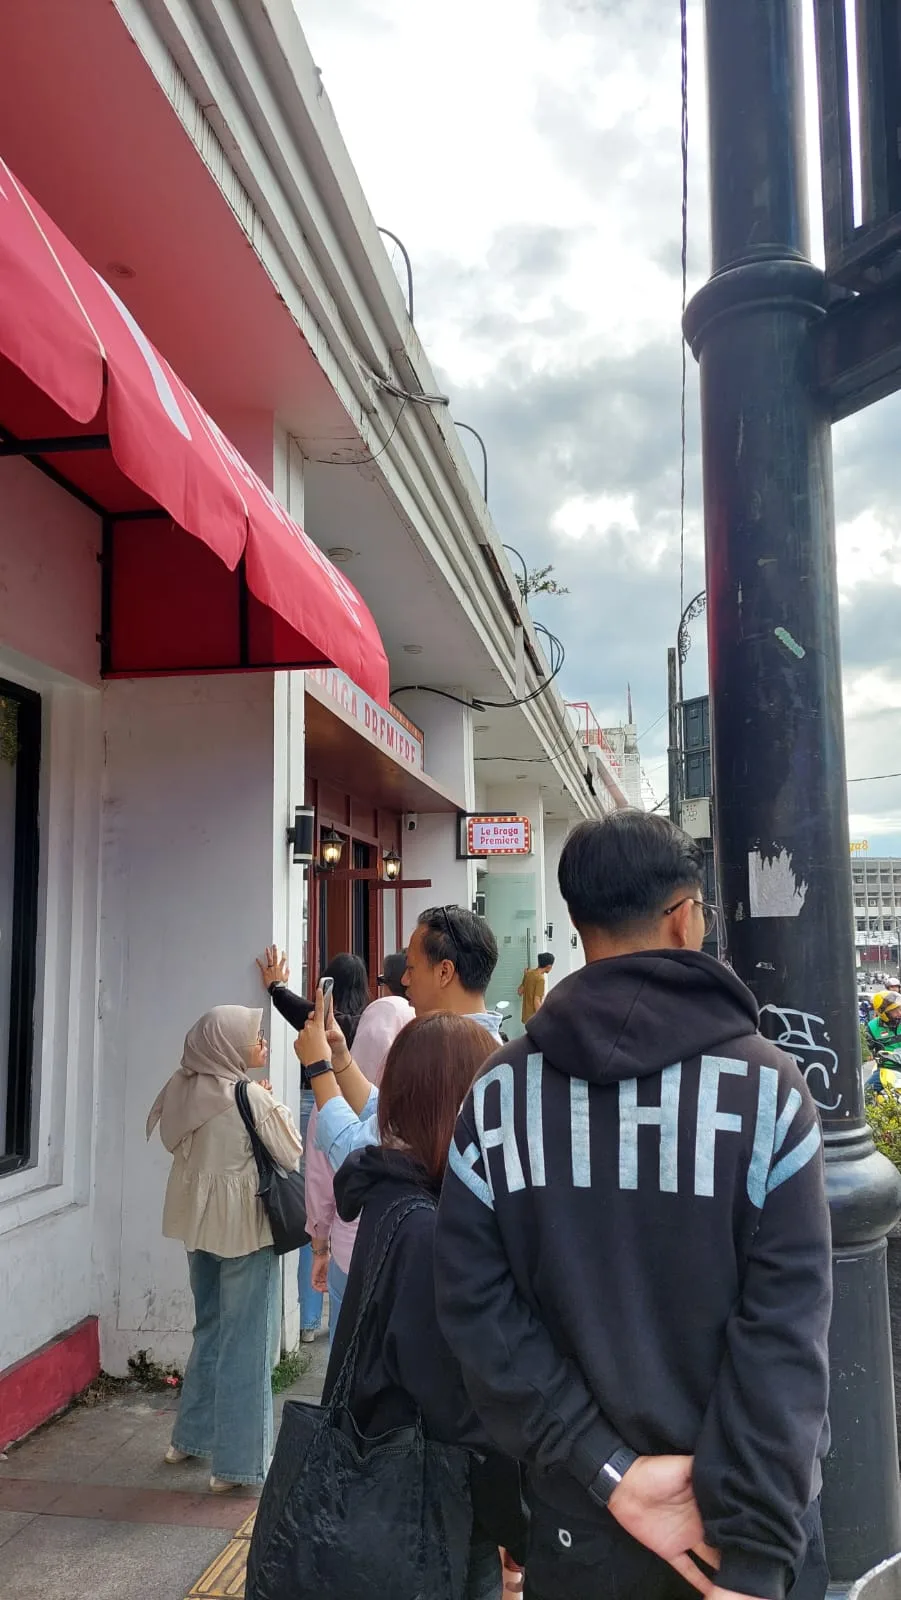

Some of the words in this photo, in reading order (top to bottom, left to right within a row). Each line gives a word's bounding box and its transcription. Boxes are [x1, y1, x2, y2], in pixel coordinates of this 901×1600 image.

[481, 827, 490, 835] Le
[493, 827, 519, 836] Braga
[480, 836, 519, 845] Premiere
